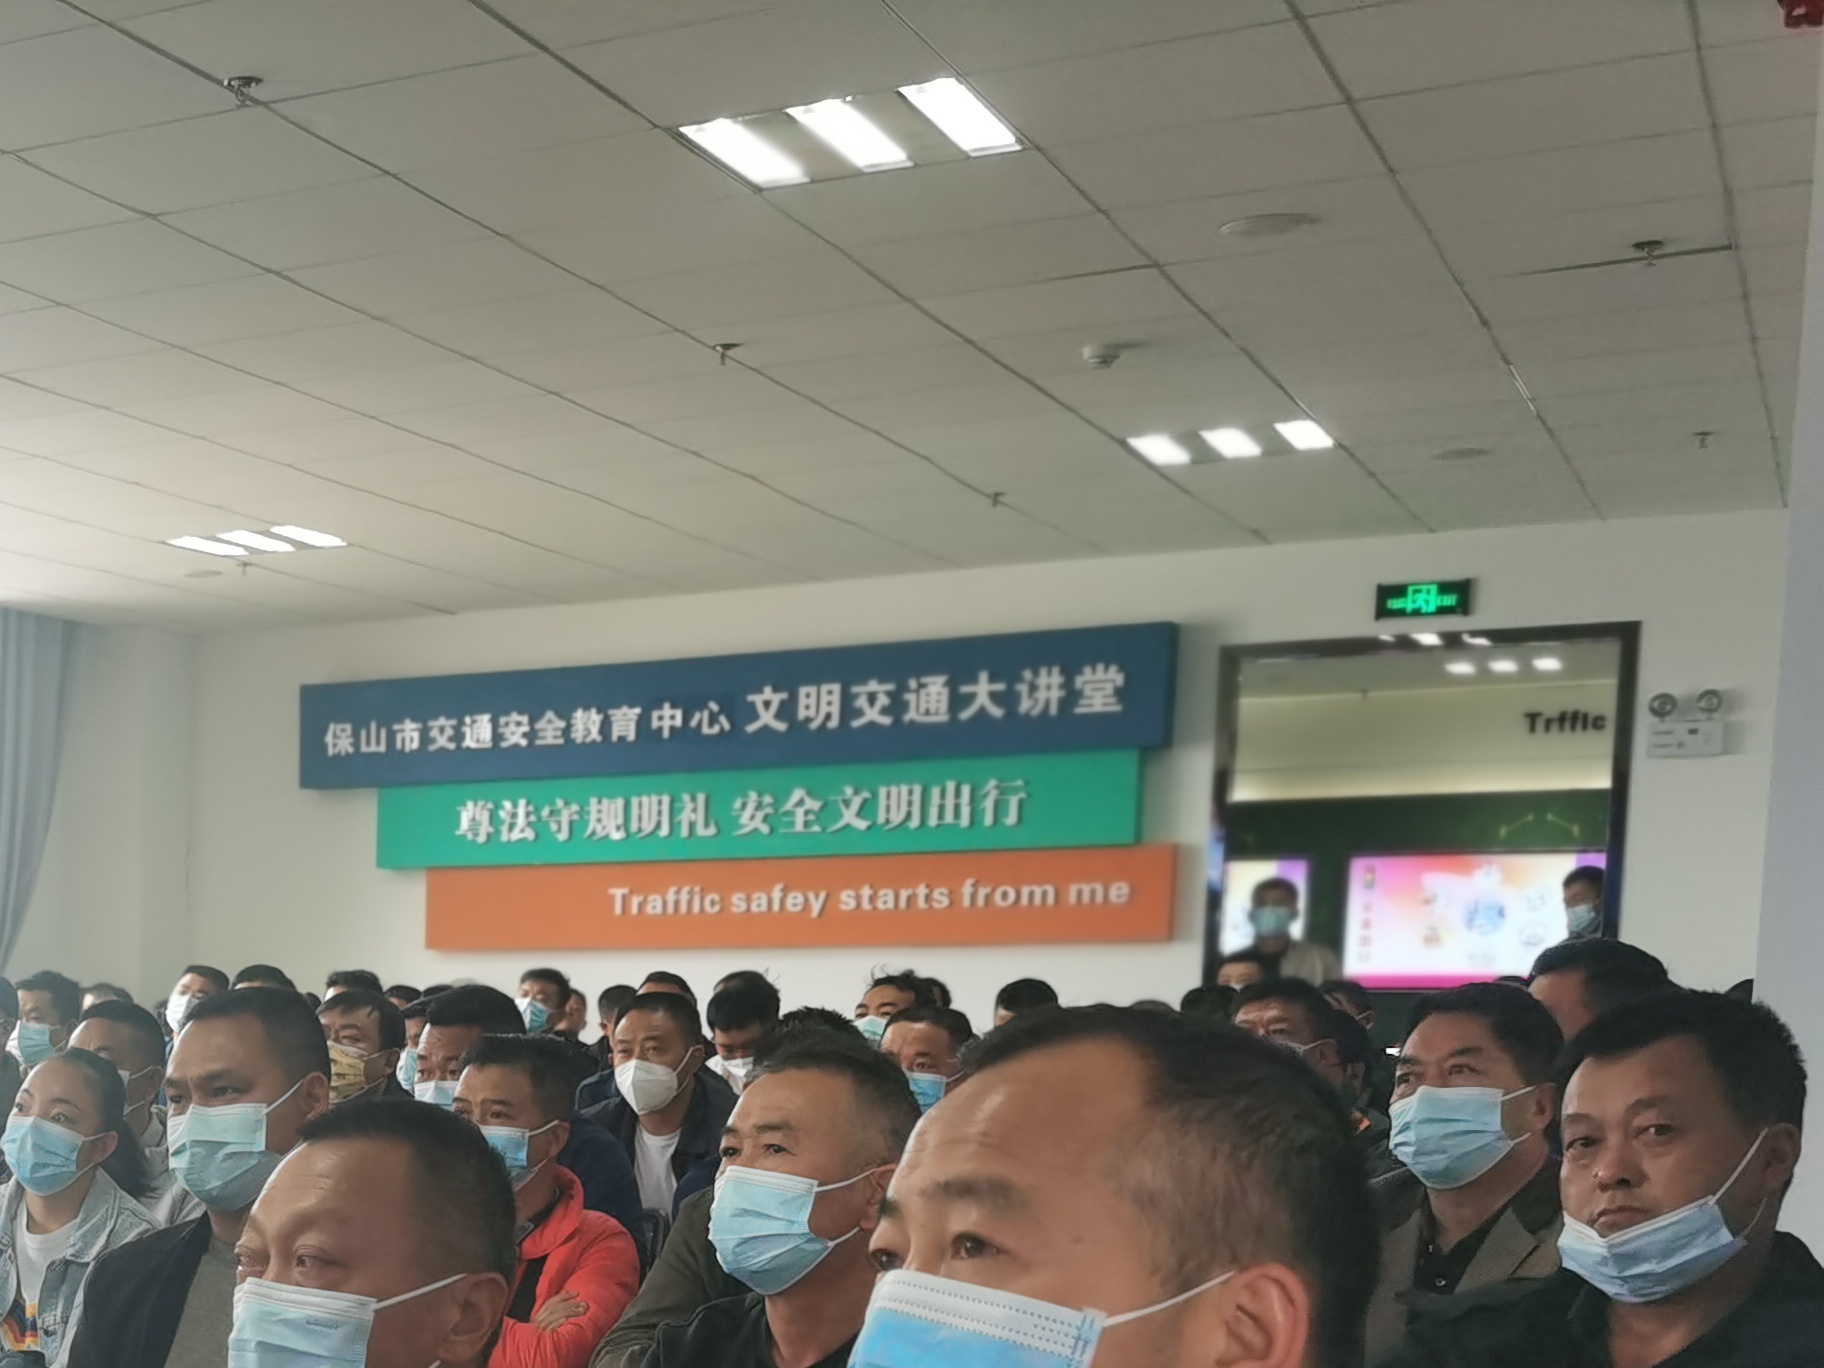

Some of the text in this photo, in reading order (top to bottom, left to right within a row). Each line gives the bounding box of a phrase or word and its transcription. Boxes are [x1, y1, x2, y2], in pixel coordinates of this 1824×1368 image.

[324, 663, 1124, 756] 保山市交通安全教育中心 文明交通大讲堂
[455, 778, 1027, 844] 尊法守规明礼 安全文明出行
[608, 878, 1131, 918] Traffic safey starts from me
